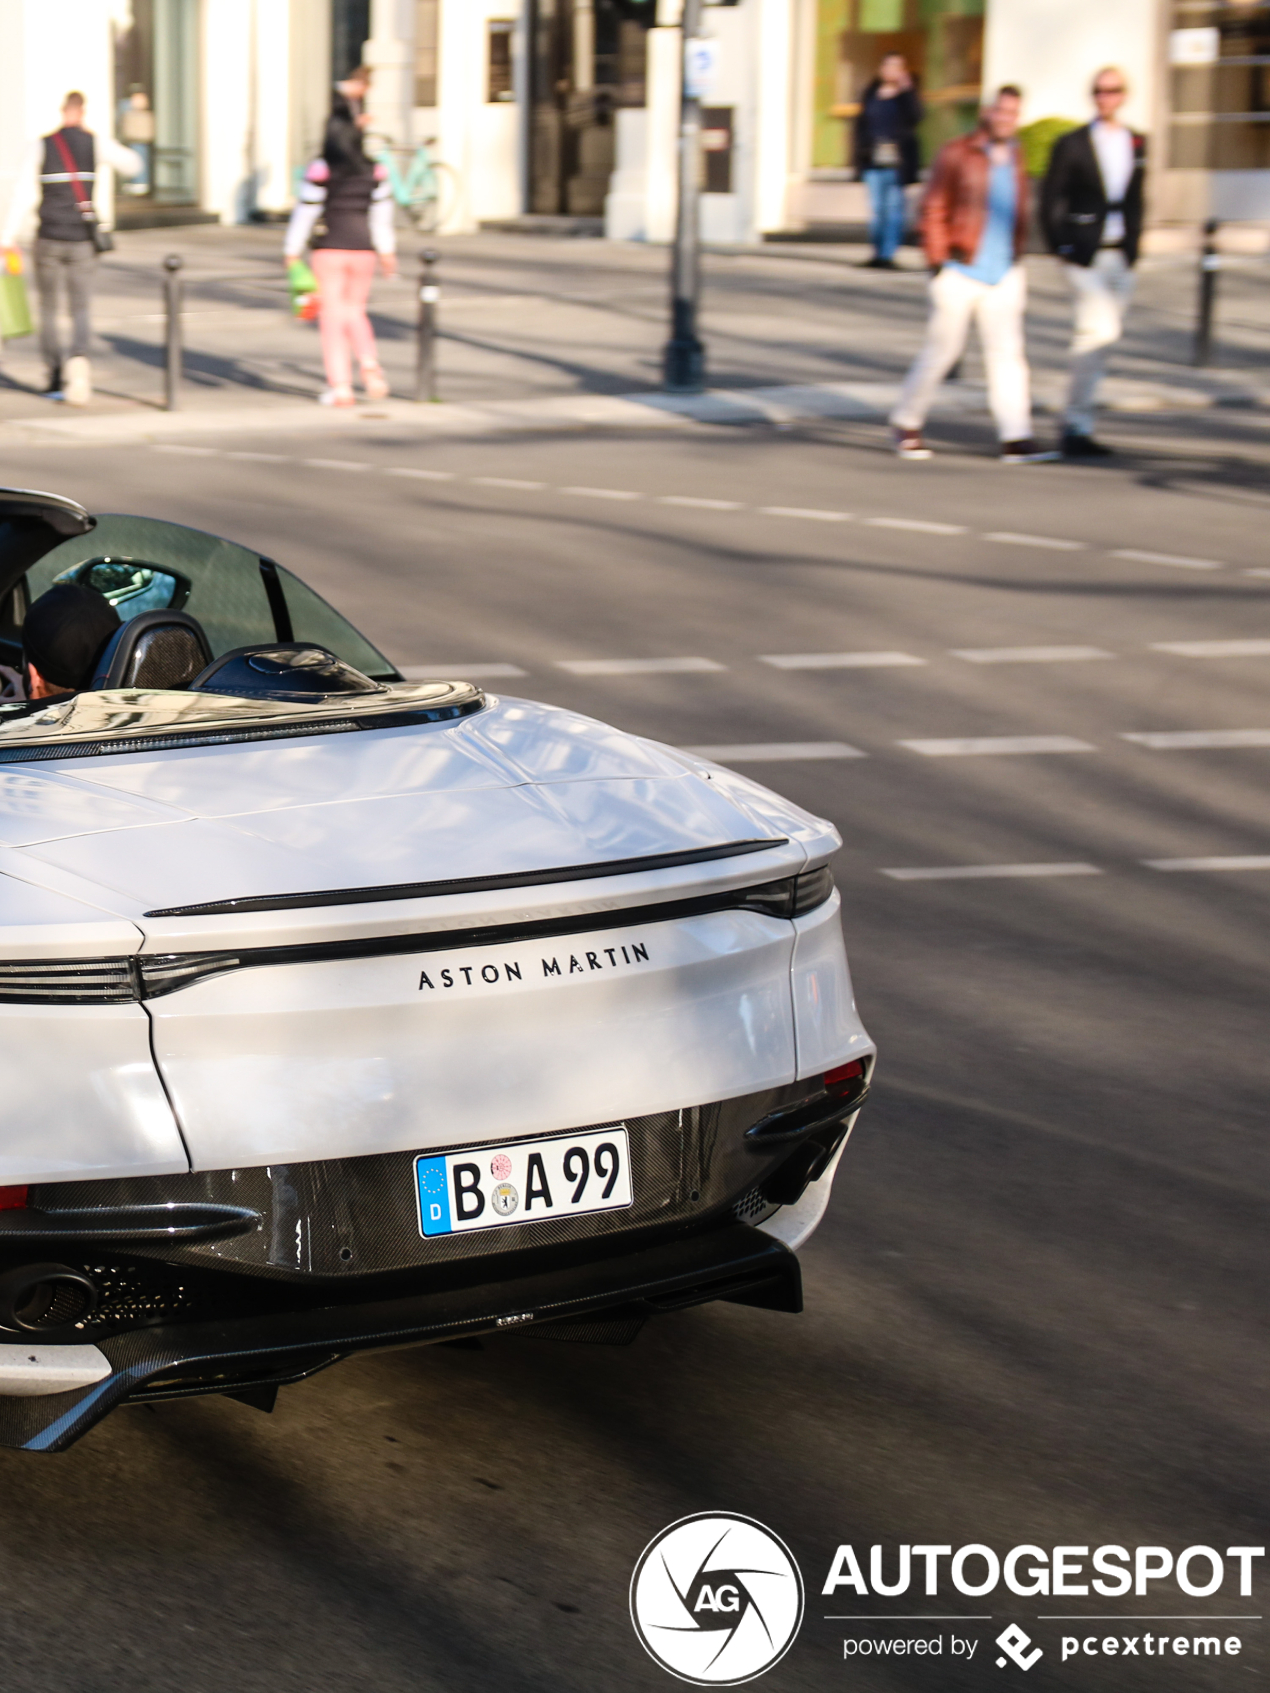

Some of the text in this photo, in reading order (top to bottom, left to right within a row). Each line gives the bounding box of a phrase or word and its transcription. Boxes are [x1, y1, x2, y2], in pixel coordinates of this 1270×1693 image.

[418, 942, 650, 991] ASTON MARTIN
[430, 1203, 442, 1221] D
[452, 1162, 486, 1221] B
